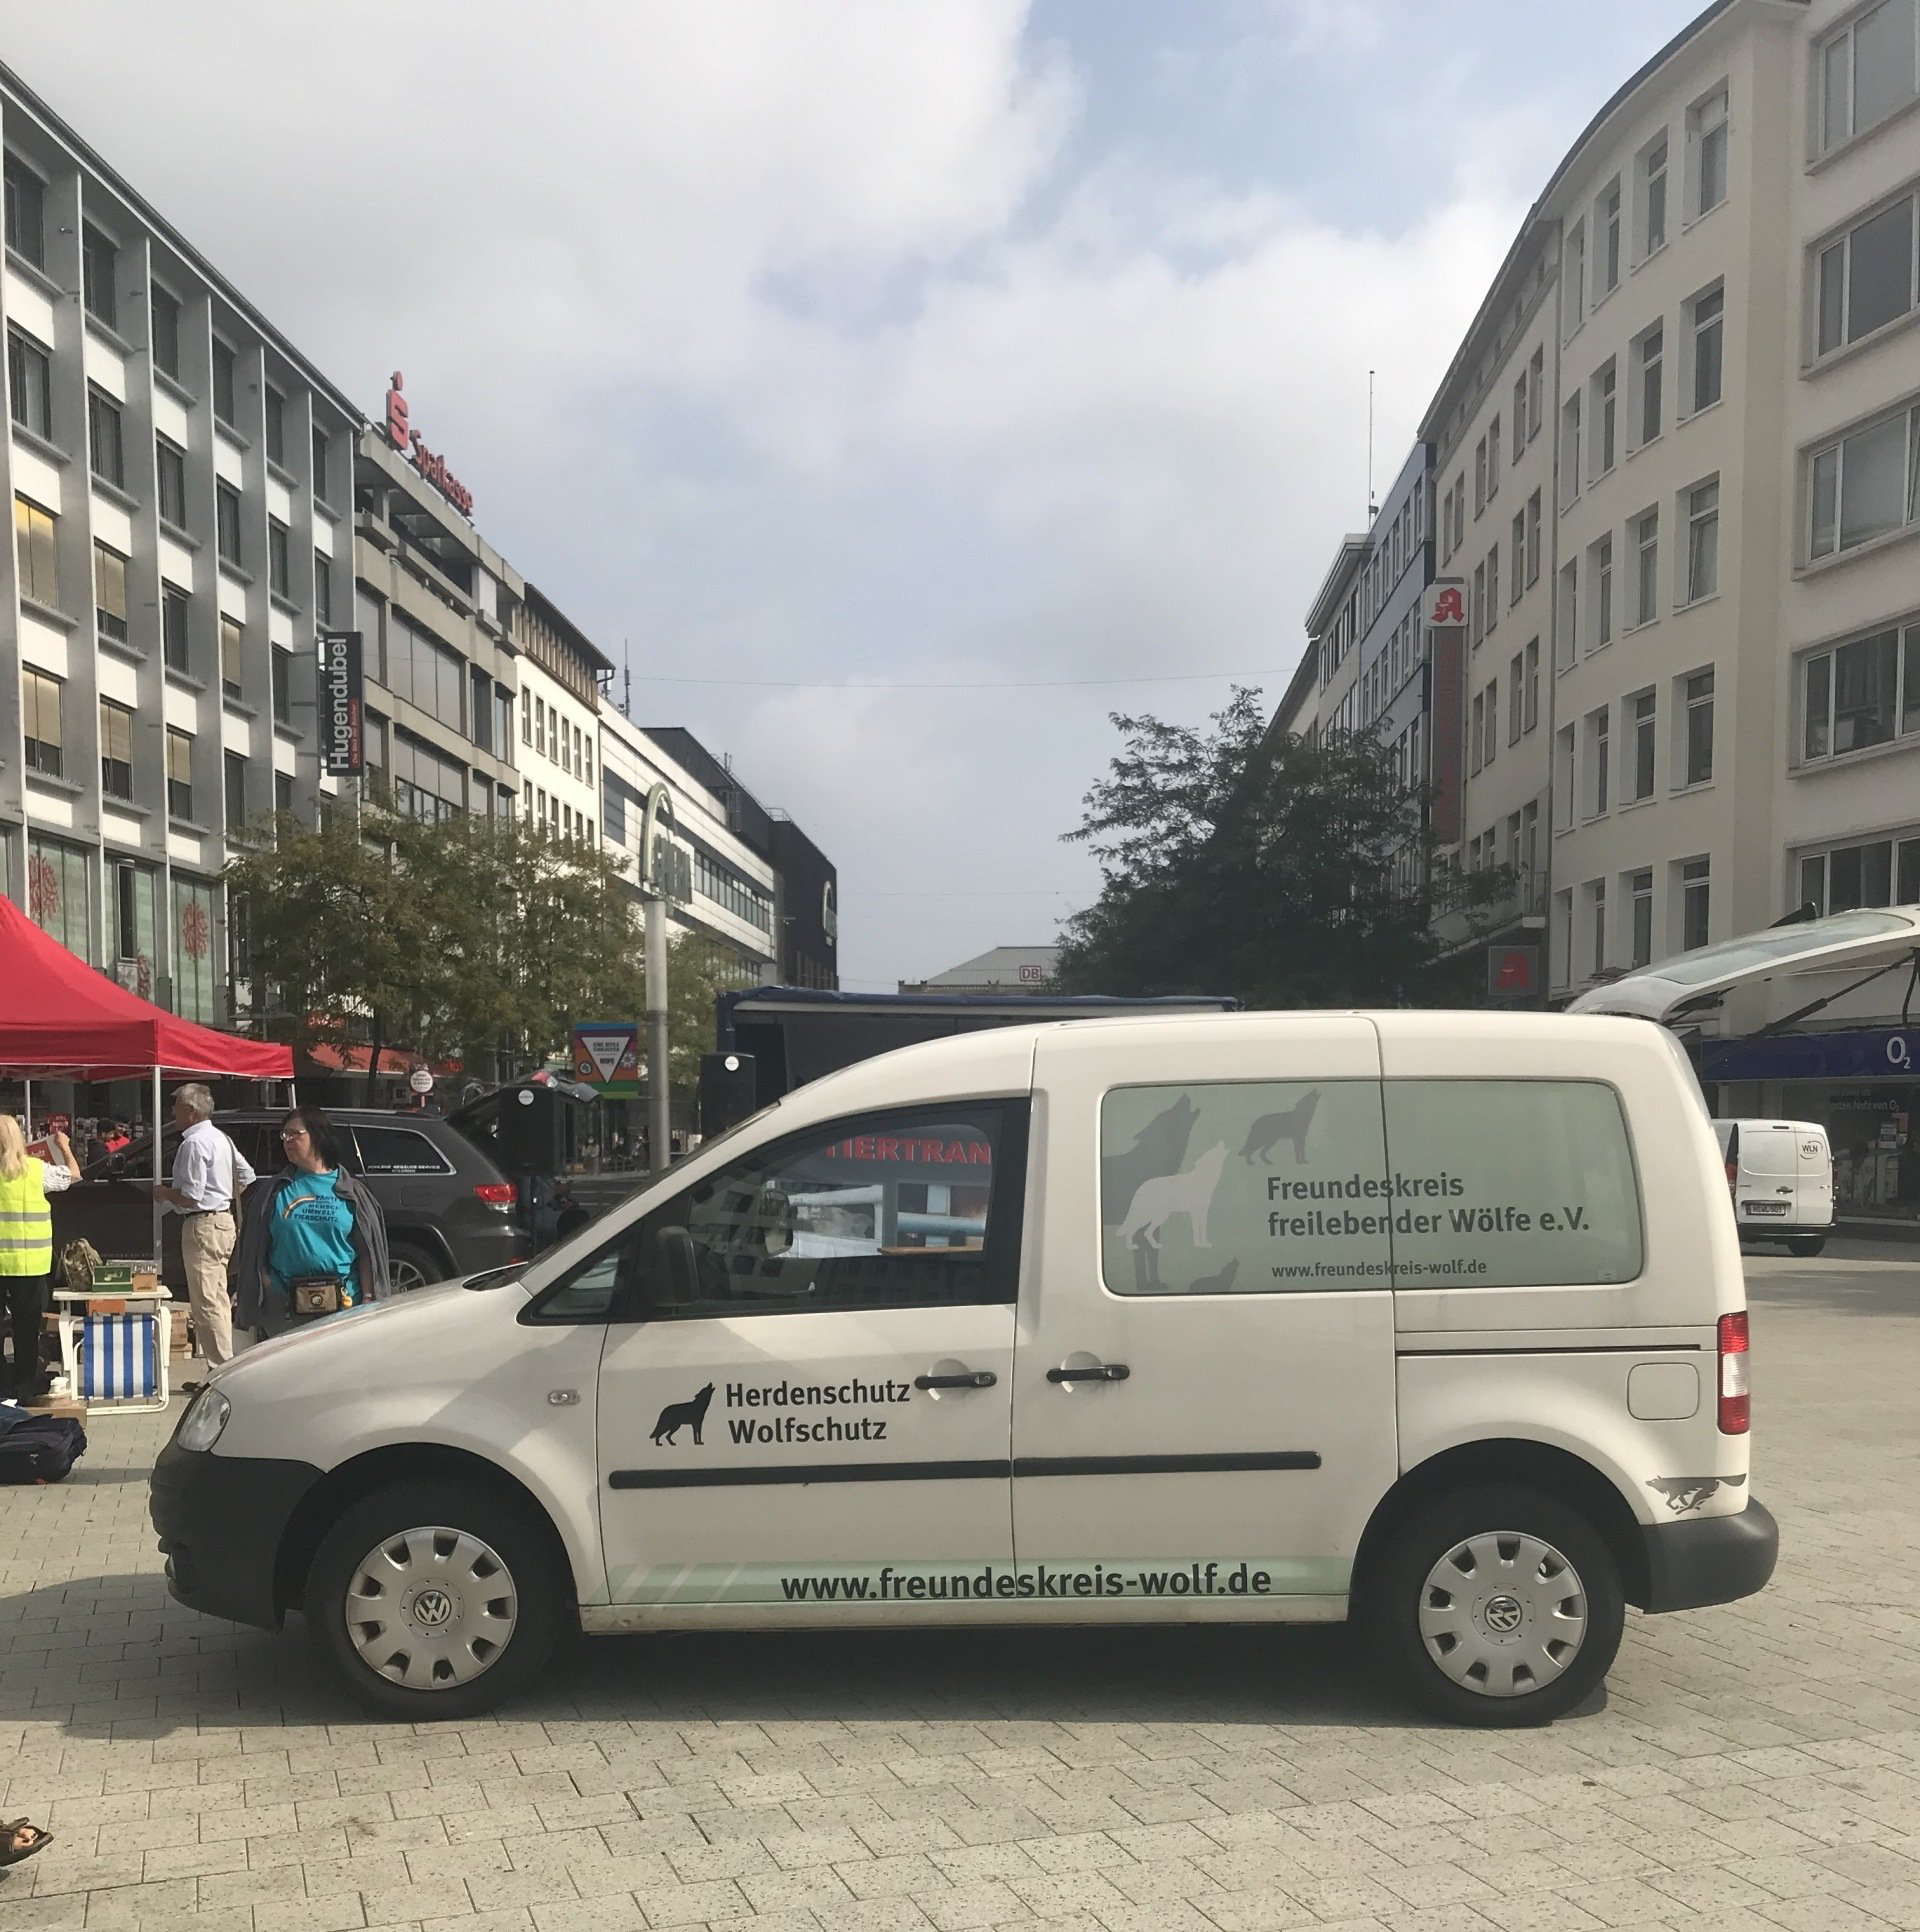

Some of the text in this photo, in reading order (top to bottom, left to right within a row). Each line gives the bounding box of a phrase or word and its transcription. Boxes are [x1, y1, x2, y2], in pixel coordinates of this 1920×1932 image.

[410, 429, 473, 514] Sparkasse
[327, 638, 352, 769] Hugendubel
[1021, 967, 1040, 980] DB
[1267, 1172, 1464, 1201] Freundeskreis
[1268, 1206, 1590, 1236] freilebender Wölfe e.V.
[1272, 1259, 1488, 1278] www.freundeskreis-wolf.de
[726, 1378, 910, 1407] Herdenschutz
[728, 1416, 887, 1444] Wolfschutz
[781, 1563, 1272, 1600] www.freundeskreis-wolf.de
